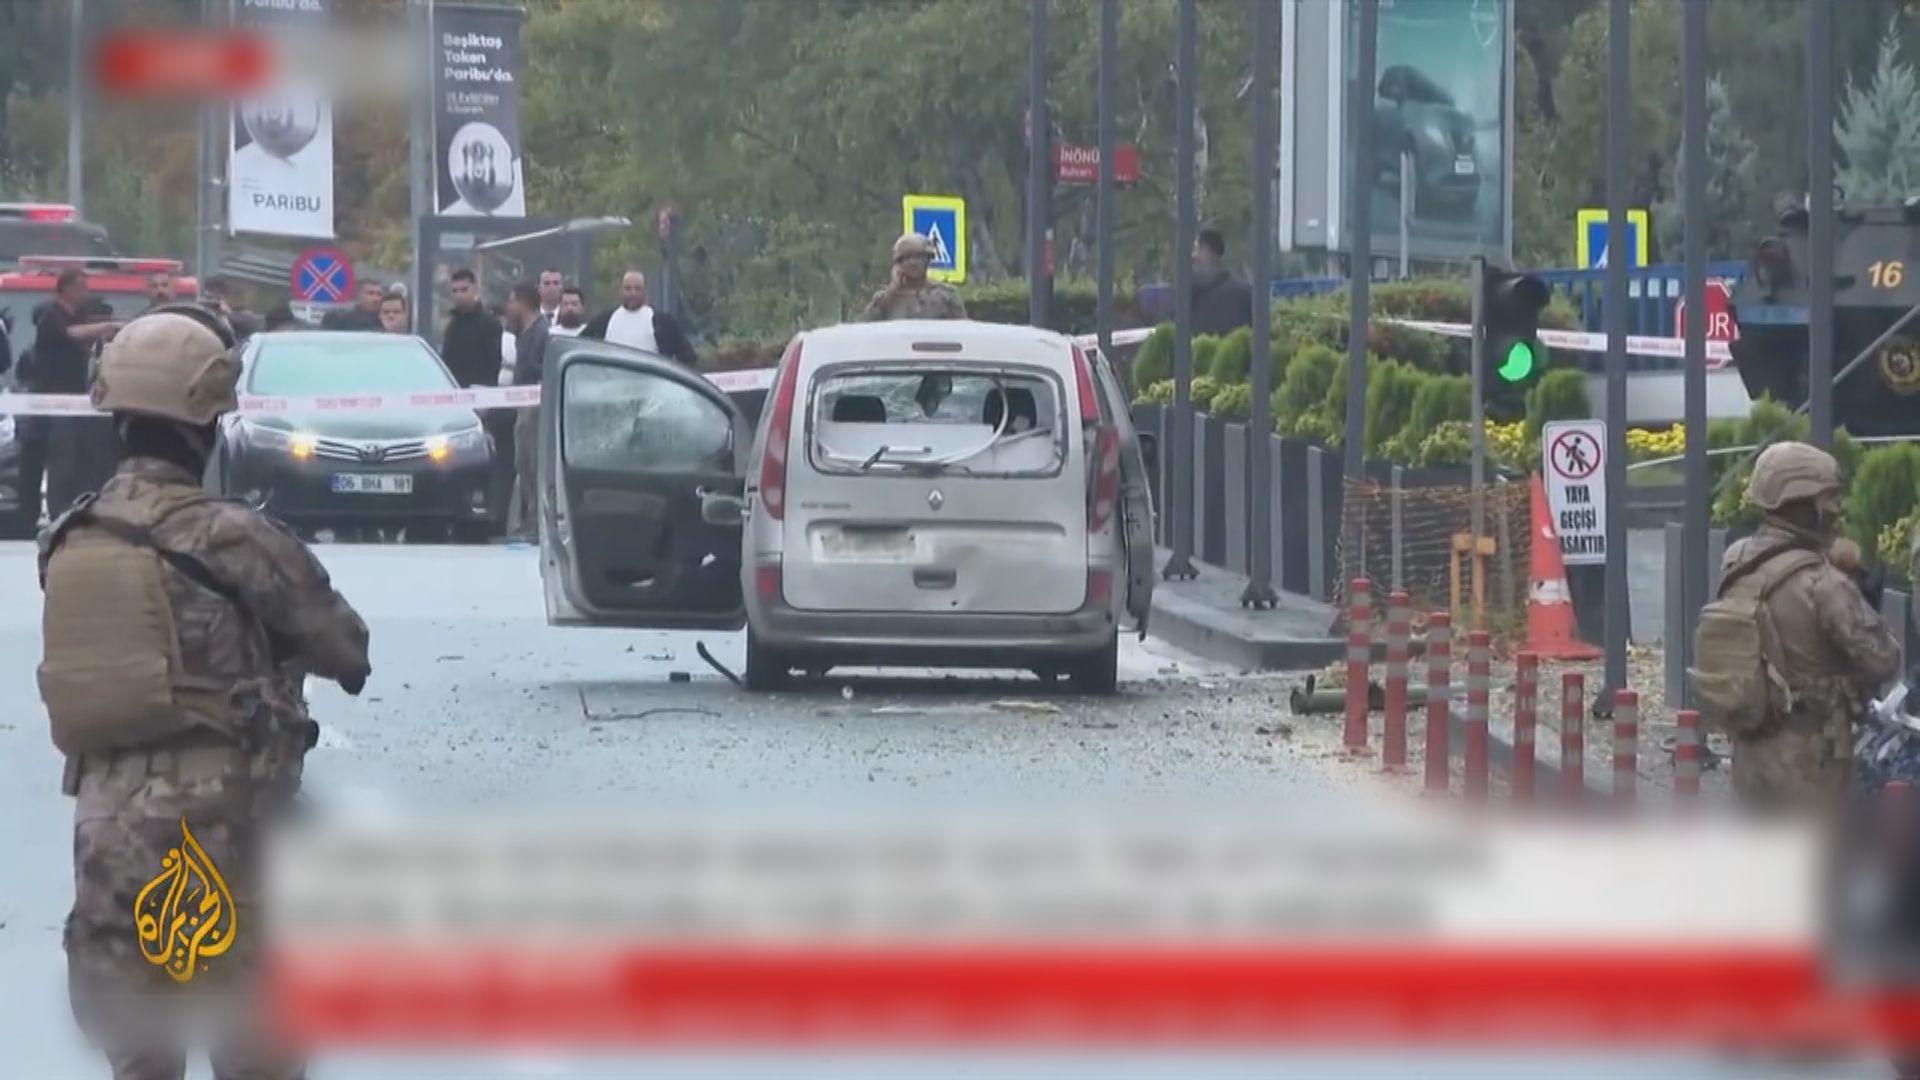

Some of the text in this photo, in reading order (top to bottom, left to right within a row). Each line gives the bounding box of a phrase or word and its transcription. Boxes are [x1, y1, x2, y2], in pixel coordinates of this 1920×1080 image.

[443, 50, 486, 63] Token
[1868, 261, 1903, 288] 16
[1564, 485, 1591, 504] YAYA
[1560, 507, 1597, 532] GEÇİŞİ
[1560, 535, 1605, 555] ASAKTIR
